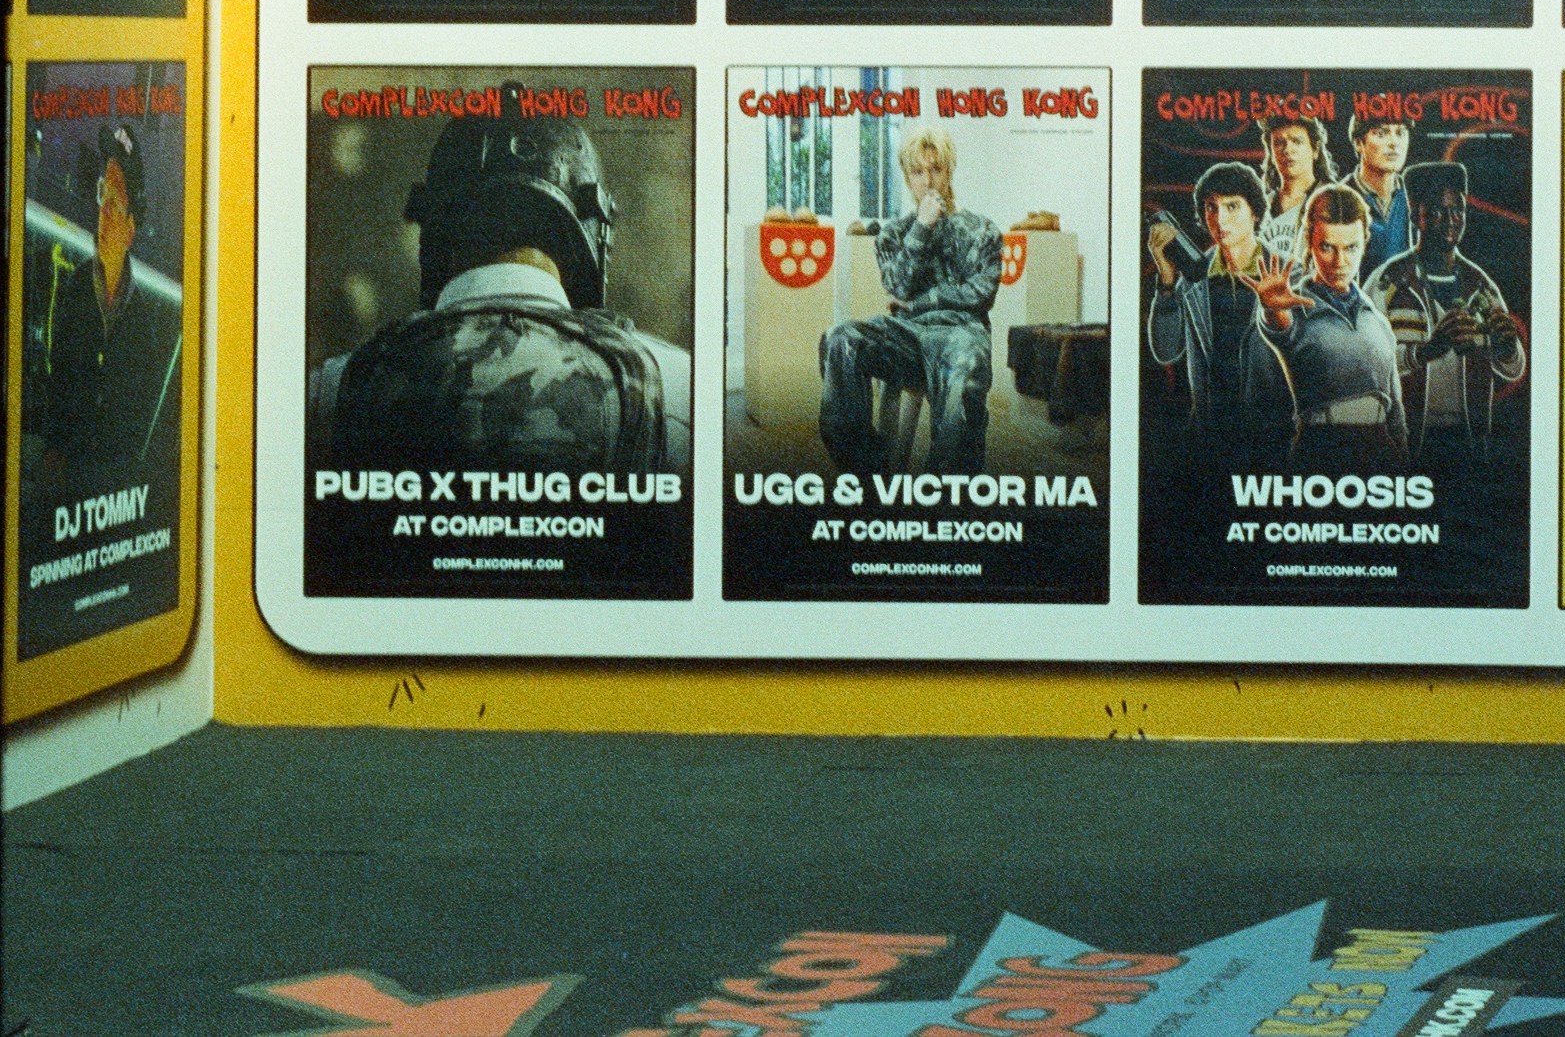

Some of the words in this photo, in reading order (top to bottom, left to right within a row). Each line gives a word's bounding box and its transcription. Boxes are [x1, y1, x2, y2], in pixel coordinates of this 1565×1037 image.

[322, 87, 502, 119] COMPLEXCON
[518, 88, 589, 118] HONG
[604, 86, 682, 119] KONG
[740, 87, 919, 117] COMPLEXCON
[937, 88, 1007, 117] HONG
[1023, 88, 1098, 118] KONG
[1156, 90, 1335, 122] COMPLEXCON
[1353, 92, 1425, 122] HONG
[1442, 90, 1518, 123] KONG
[315, 470, 422, 501] PUBG
[430, 471, 456, 501] X
[462, 471, 571, 503] THUG
[578, 472, 682, 503] CLUB
[734, 472, 825, 505] UGG
[832, 473, 864, 506] &
[872, 473, 1026, 507] VICTOR
[1034, 475, 1098, 507] MA
[1231, 474, 1435, 509] WHOOSIS
[55, 503, 81, 542] DJ
[83, 484, 149, 533] TOMMY
[393, 515, 427, 536] AT
[430, 515, 605, 538] COMPLEXCON
[811, 520, 845, 540] AT
[849, 519, 1023, 542] COMPLEXCON
[1226, 522, 1260, 542] AT
[1264, 522, 1440, 544] COMPLEXCON
[30, 553, 83, 589] SPINNING
[84, 549, 99, 572] AT
[99, 527, 171, 568] COMPLEXCON
[432, 557, 564, 571] COMPLEXCONHK.COM
[851, 562, 982, 576] COMPLEXCONHK.COM
[1266, 564, 1398, 577] COMPLEXCONHK.COM
